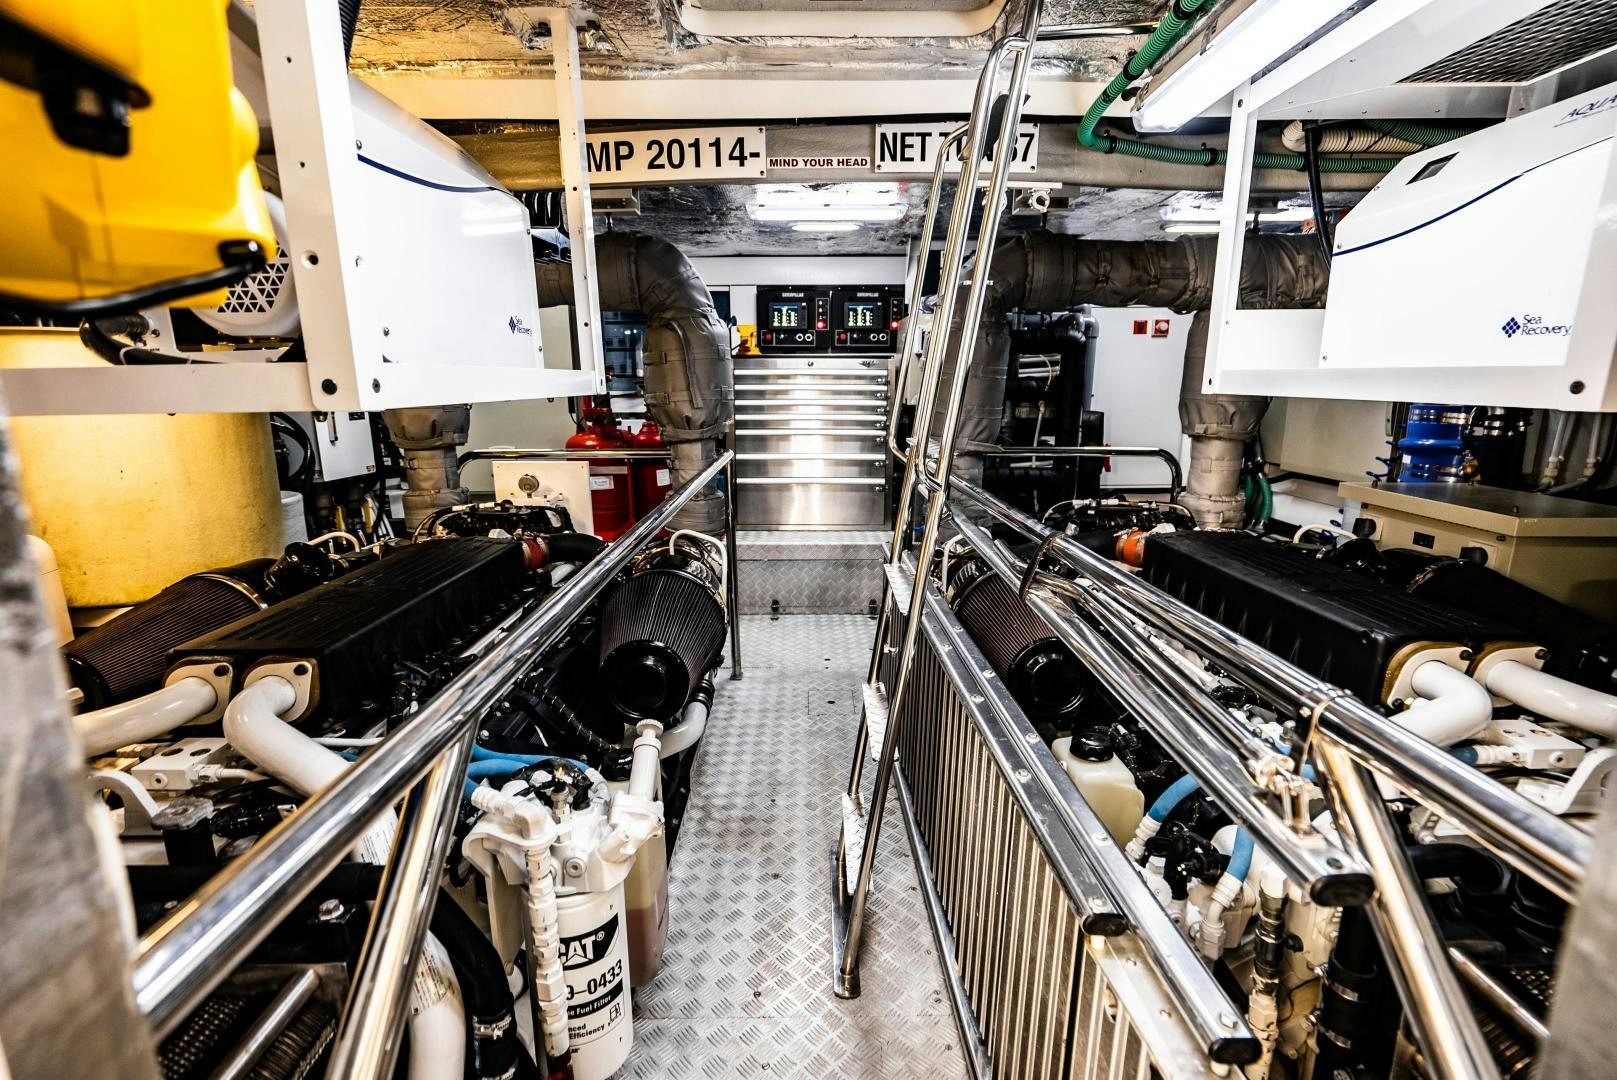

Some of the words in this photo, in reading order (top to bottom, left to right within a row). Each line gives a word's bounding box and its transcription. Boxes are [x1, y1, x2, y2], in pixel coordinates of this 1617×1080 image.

[646, 136, 761, 170] 20114-
[879, 132, 932, 162] NET
[769, 158, 799, 167] MIND
[802, 158, 834, 167] YOUR
[837, 158, 868, 167] HEAD
[1522, 314, 1542, 325] Sea
[1521, 325, 1571, 337] Recovery
[576, 1003, 593, 1015] Fuel
[593, 995, 611, 1009] Filter
[568, 1024, 605, 1040] Efficiency
